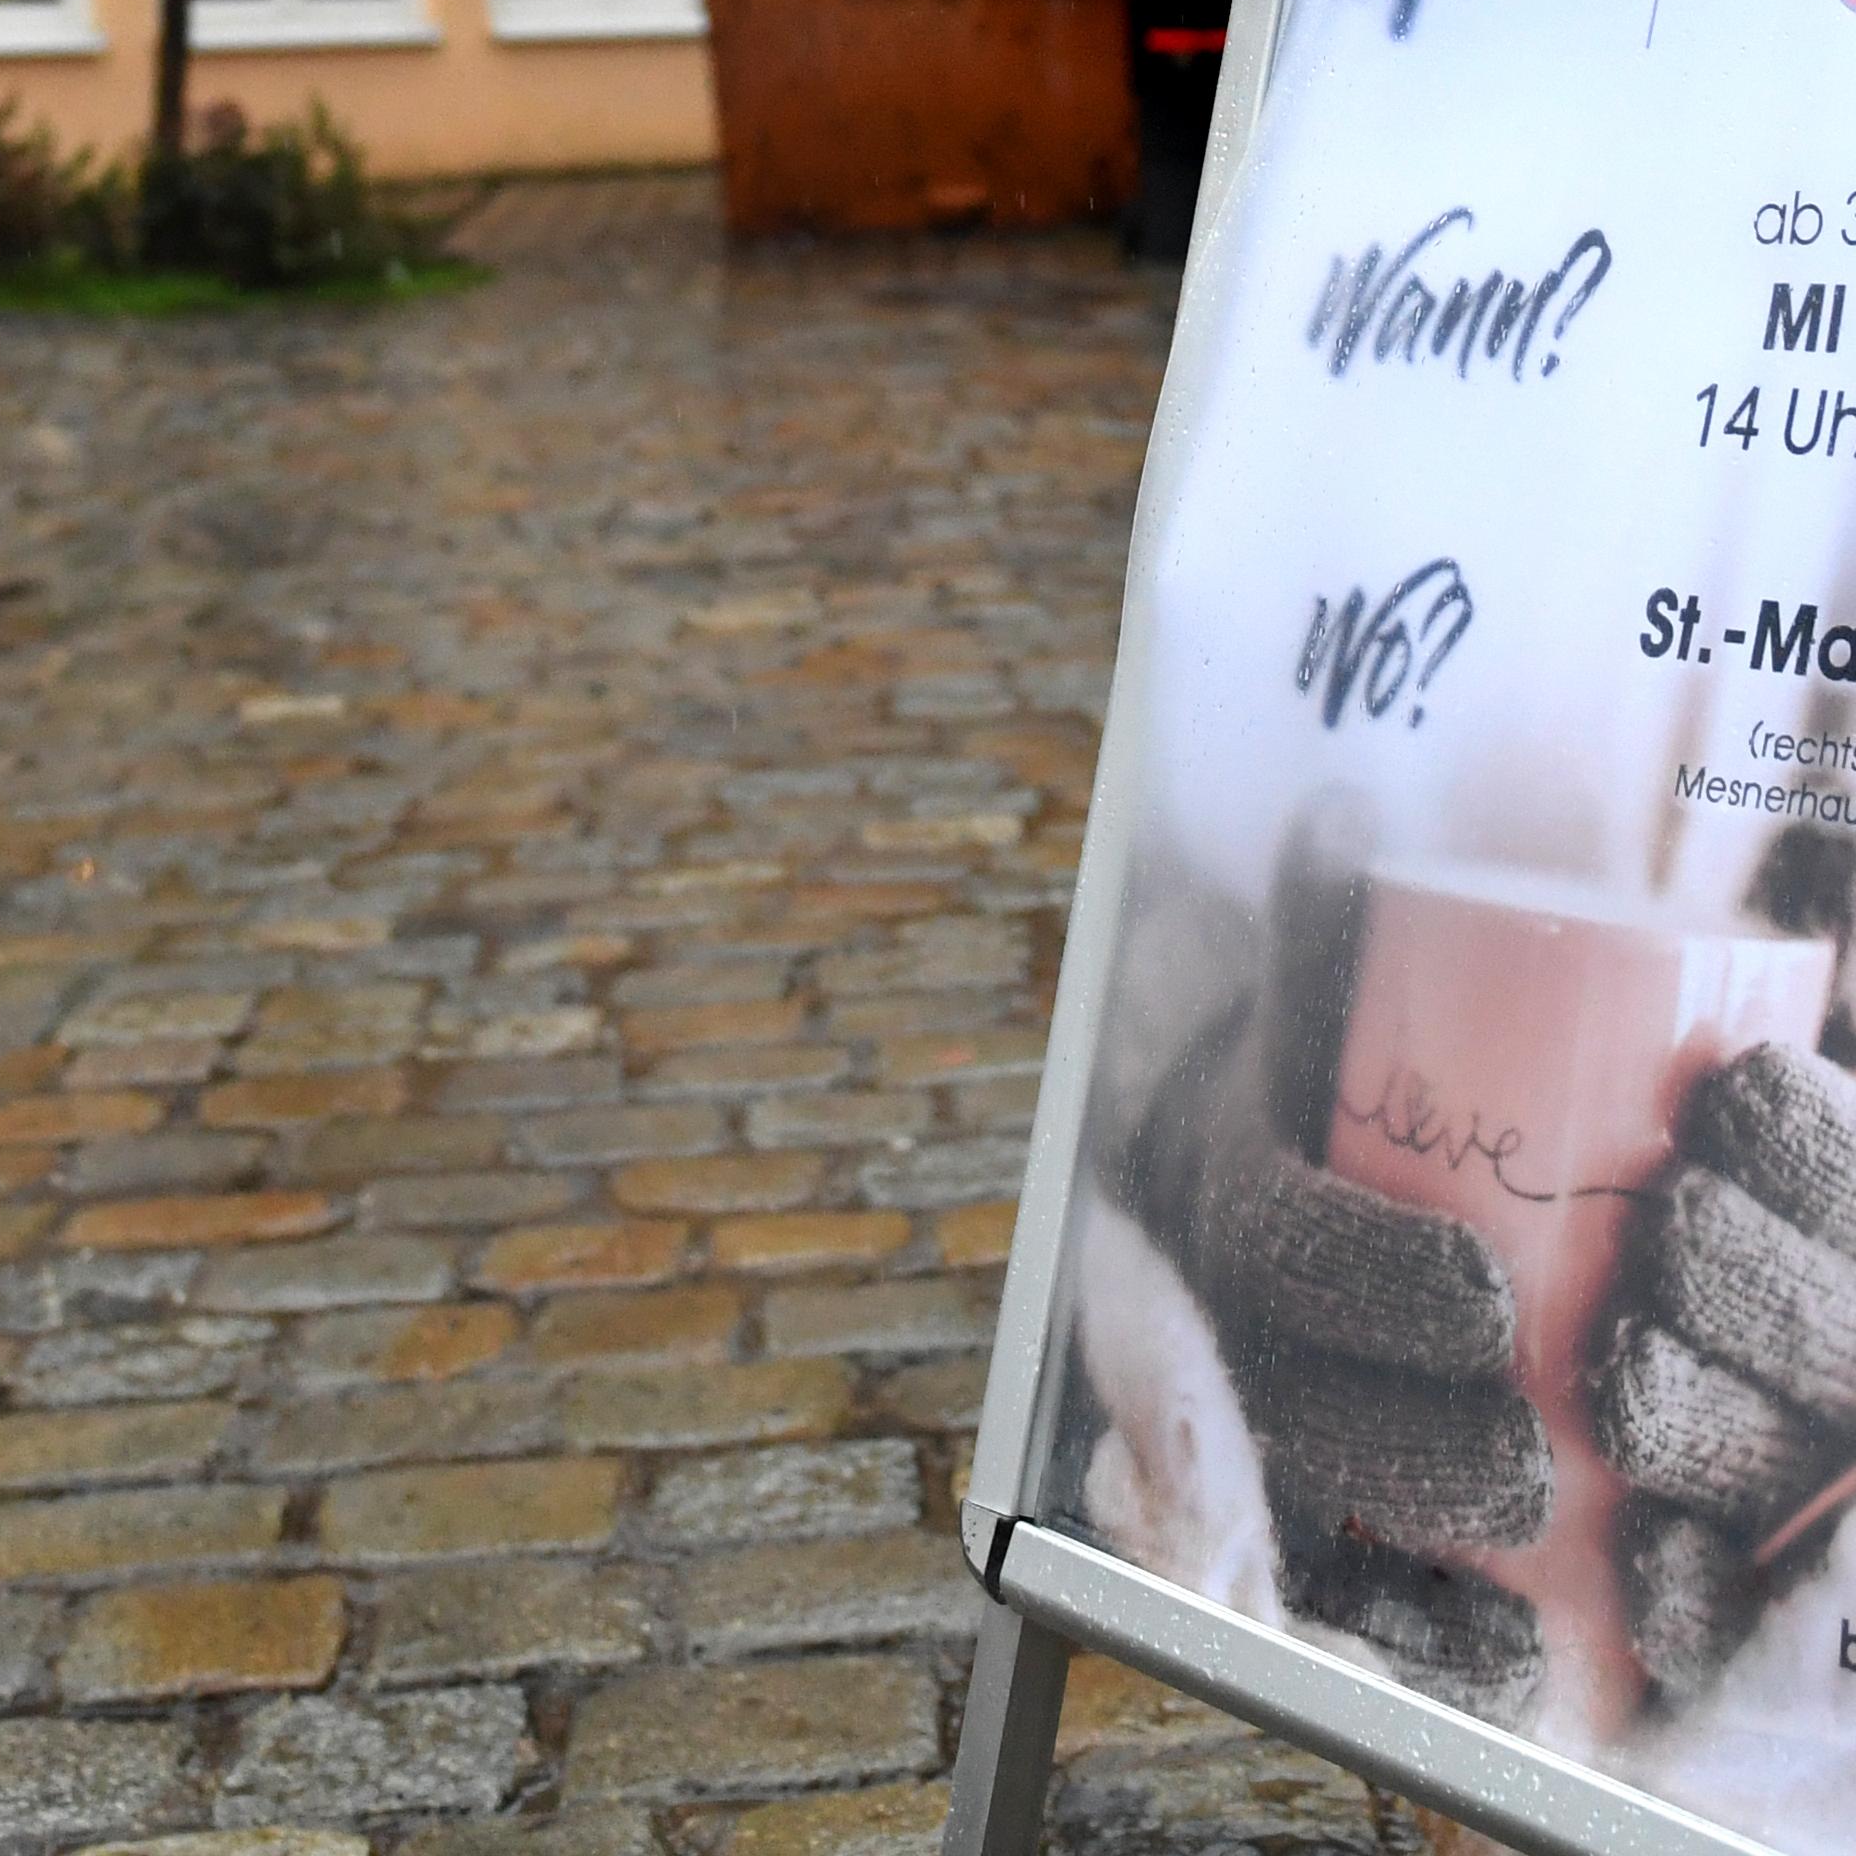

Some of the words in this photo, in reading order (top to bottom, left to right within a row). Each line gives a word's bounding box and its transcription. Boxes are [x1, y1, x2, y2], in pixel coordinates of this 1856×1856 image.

[1752, 189, 1825, 247] ab
[1305, 204, 1613, 384] Wann?
[1761, 281, 1847, 355] MI
[1695, 382, 1761, 451] 14
[1295, 555, 1474, 730] Wo?
